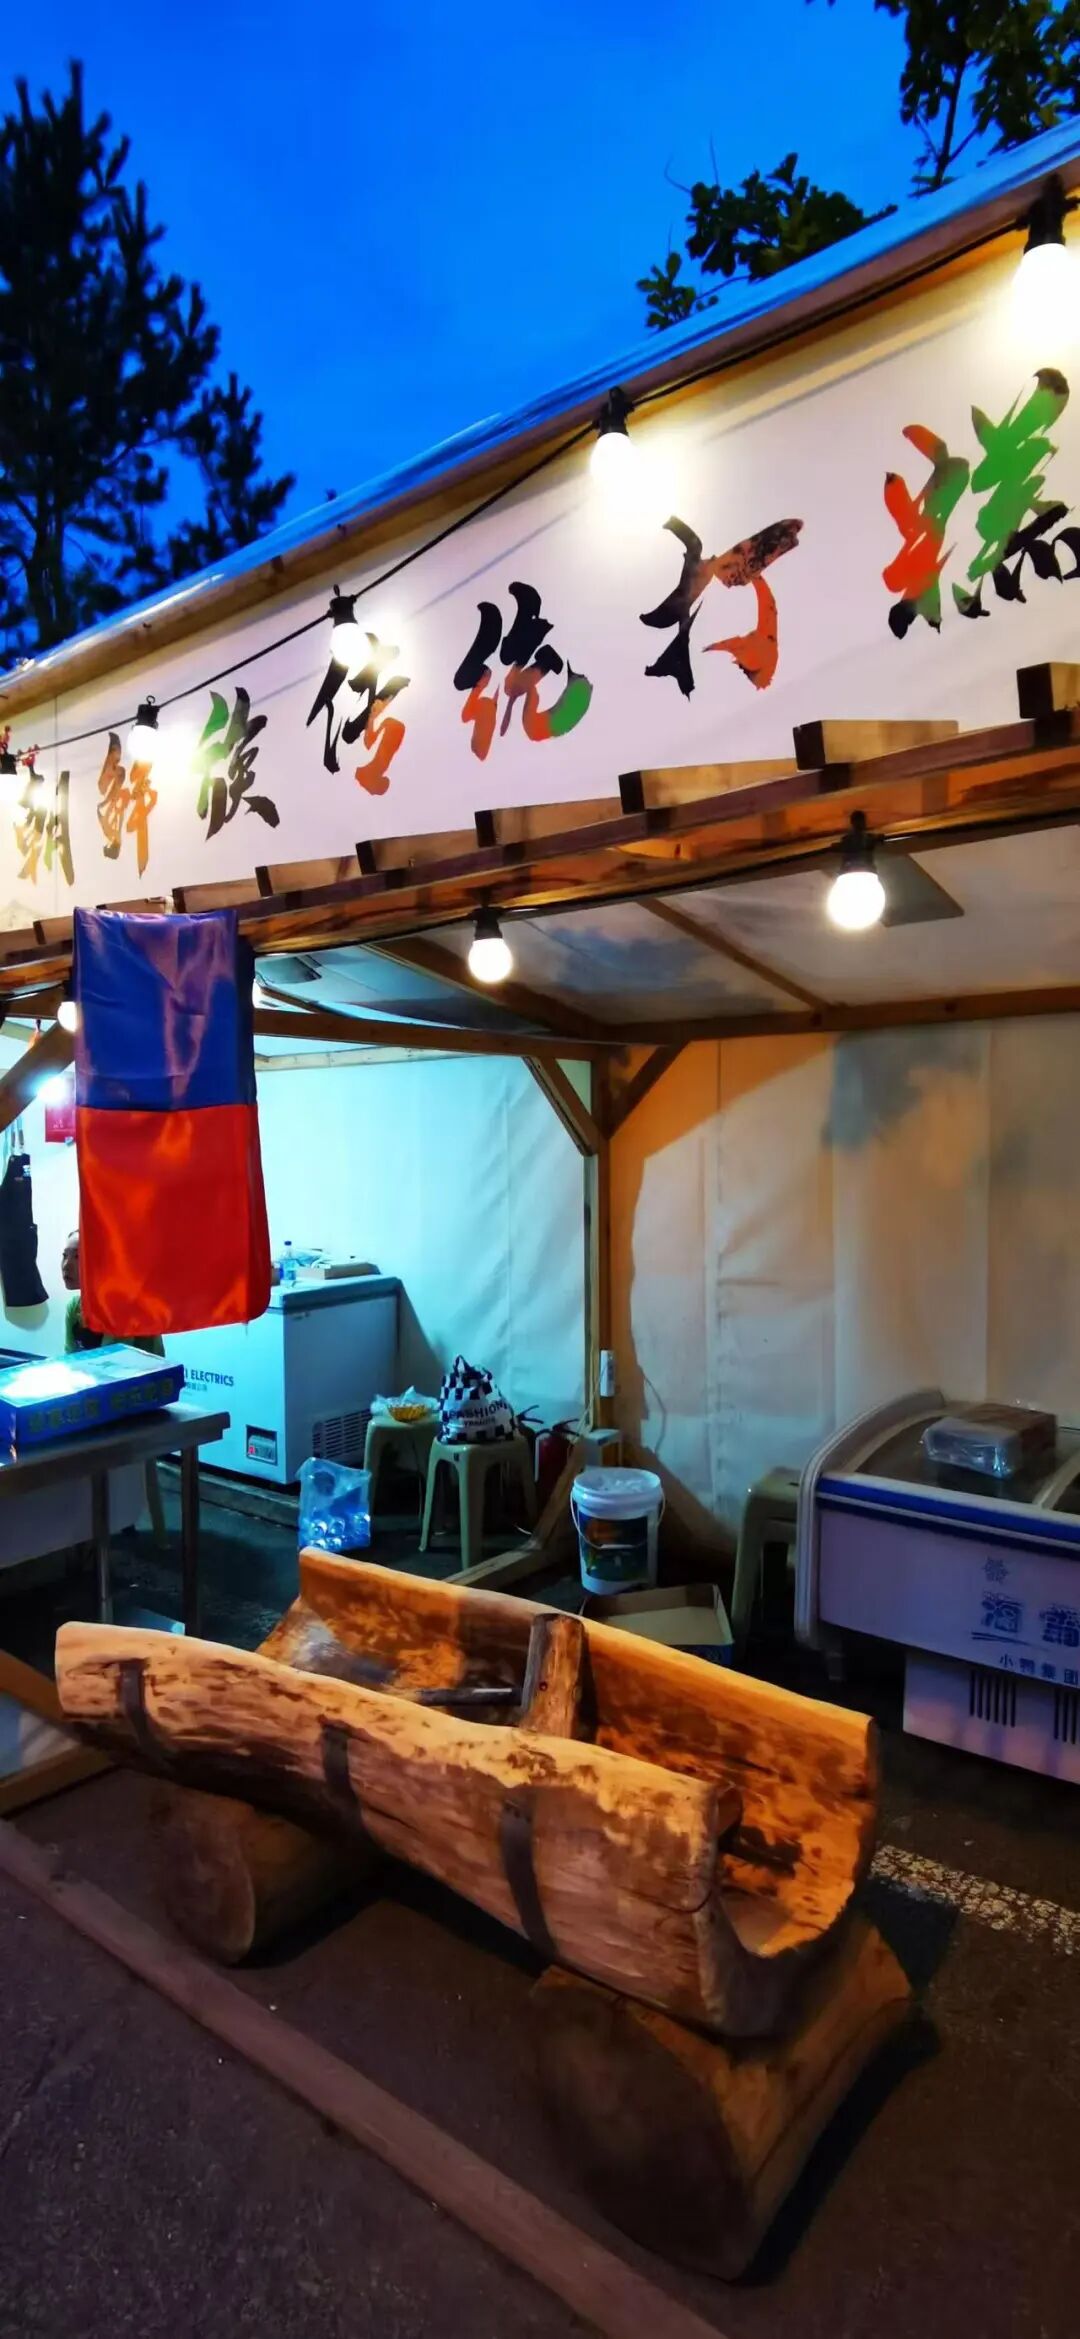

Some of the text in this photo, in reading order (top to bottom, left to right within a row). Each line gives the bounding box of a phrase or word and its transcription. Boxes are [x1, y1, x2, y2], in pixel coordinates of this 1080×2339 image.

[13, 367, 1080, 887] 朝鲜族传统打糕
[190, 1369, 234, 1387] ELECTRICS
